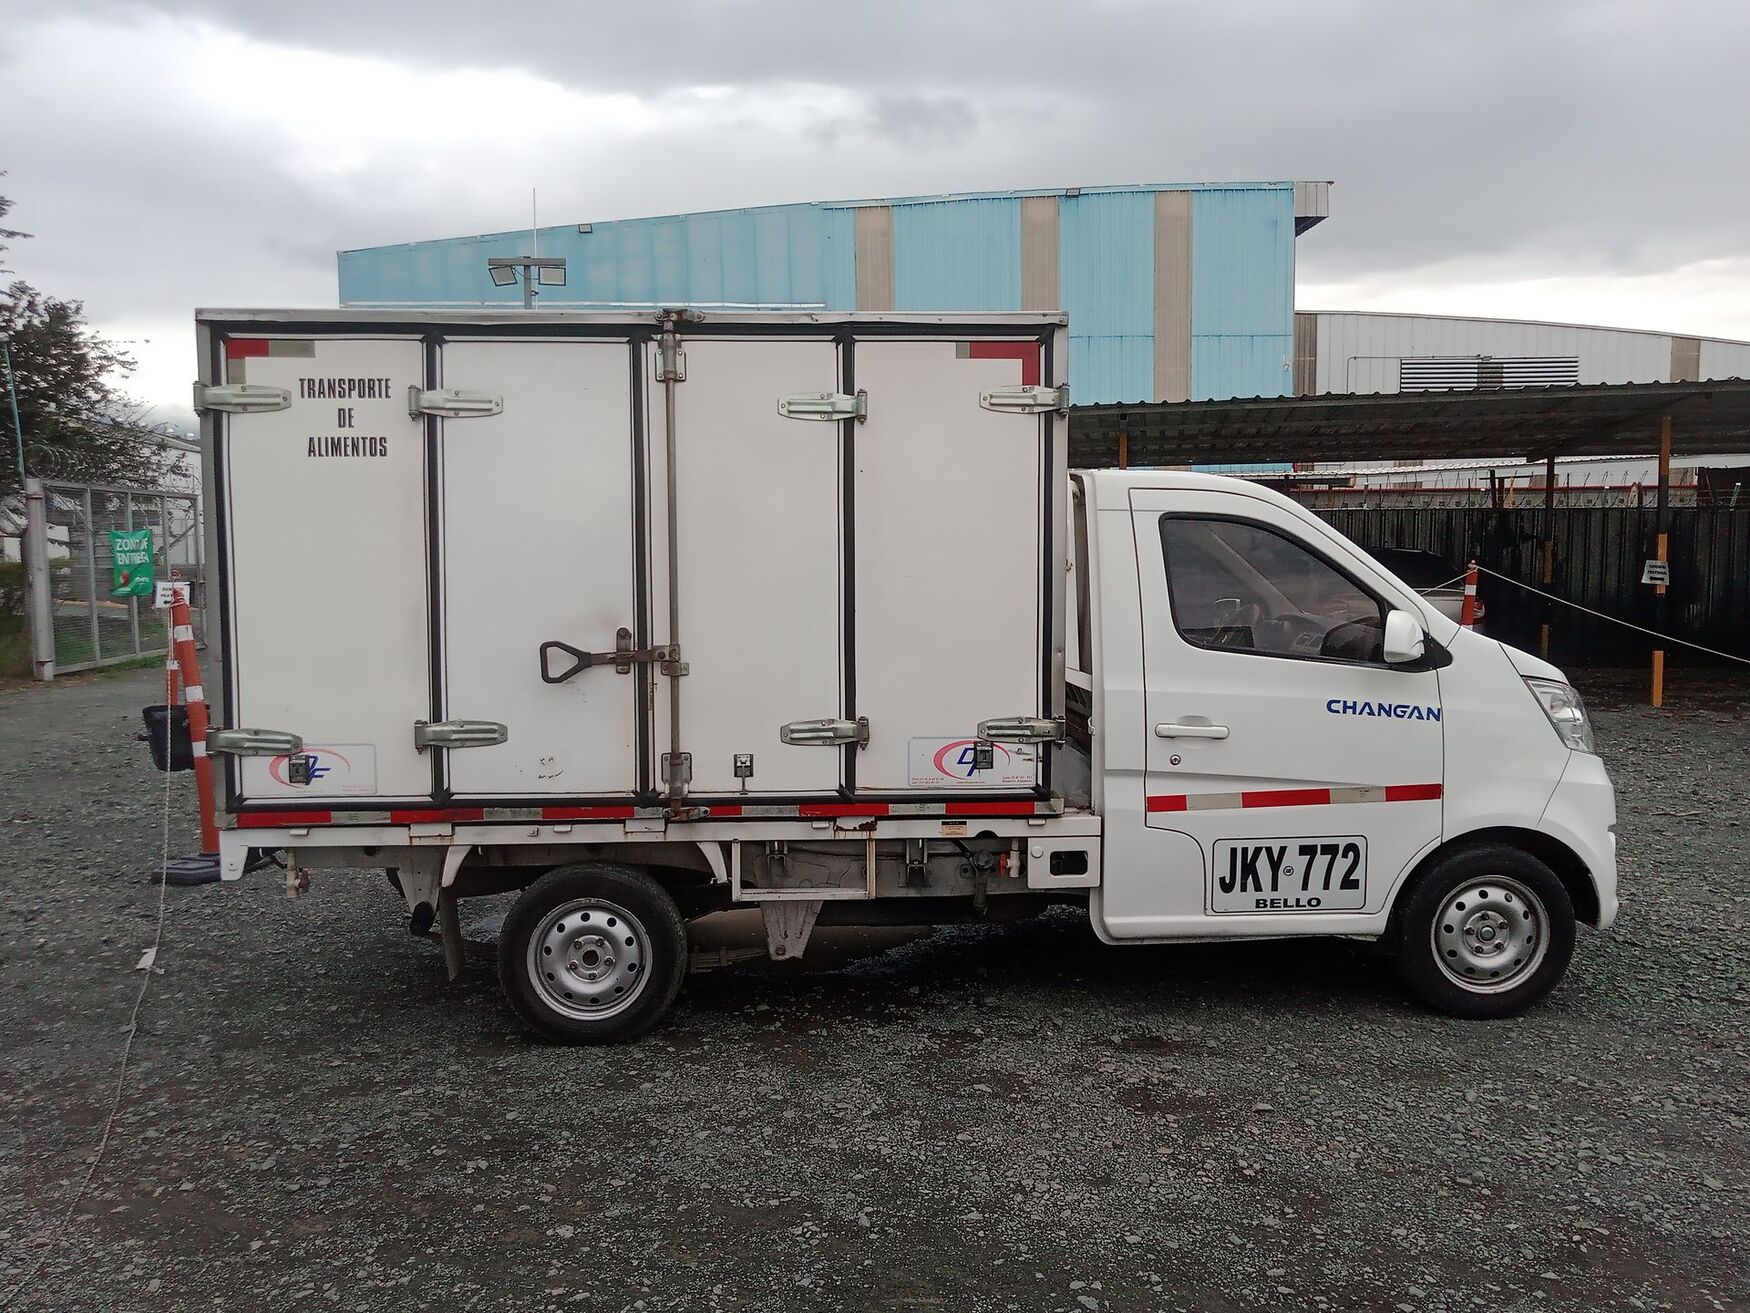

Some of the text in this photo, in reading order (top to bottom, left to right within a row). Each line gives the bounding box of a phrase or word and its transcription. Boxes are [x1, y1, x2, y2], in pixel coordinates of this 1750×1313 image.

[299, 378, 392, 399] TRANSPORTE
[337, 408, 355, 428] DE
[308, 437, 388, 457] ALIMENTOS
[1326, 699, 1441, 722] CHANGAN
[1218, 842, 1361, 894] JKY 772
[1255, 897, 1322, 909] BELLO
